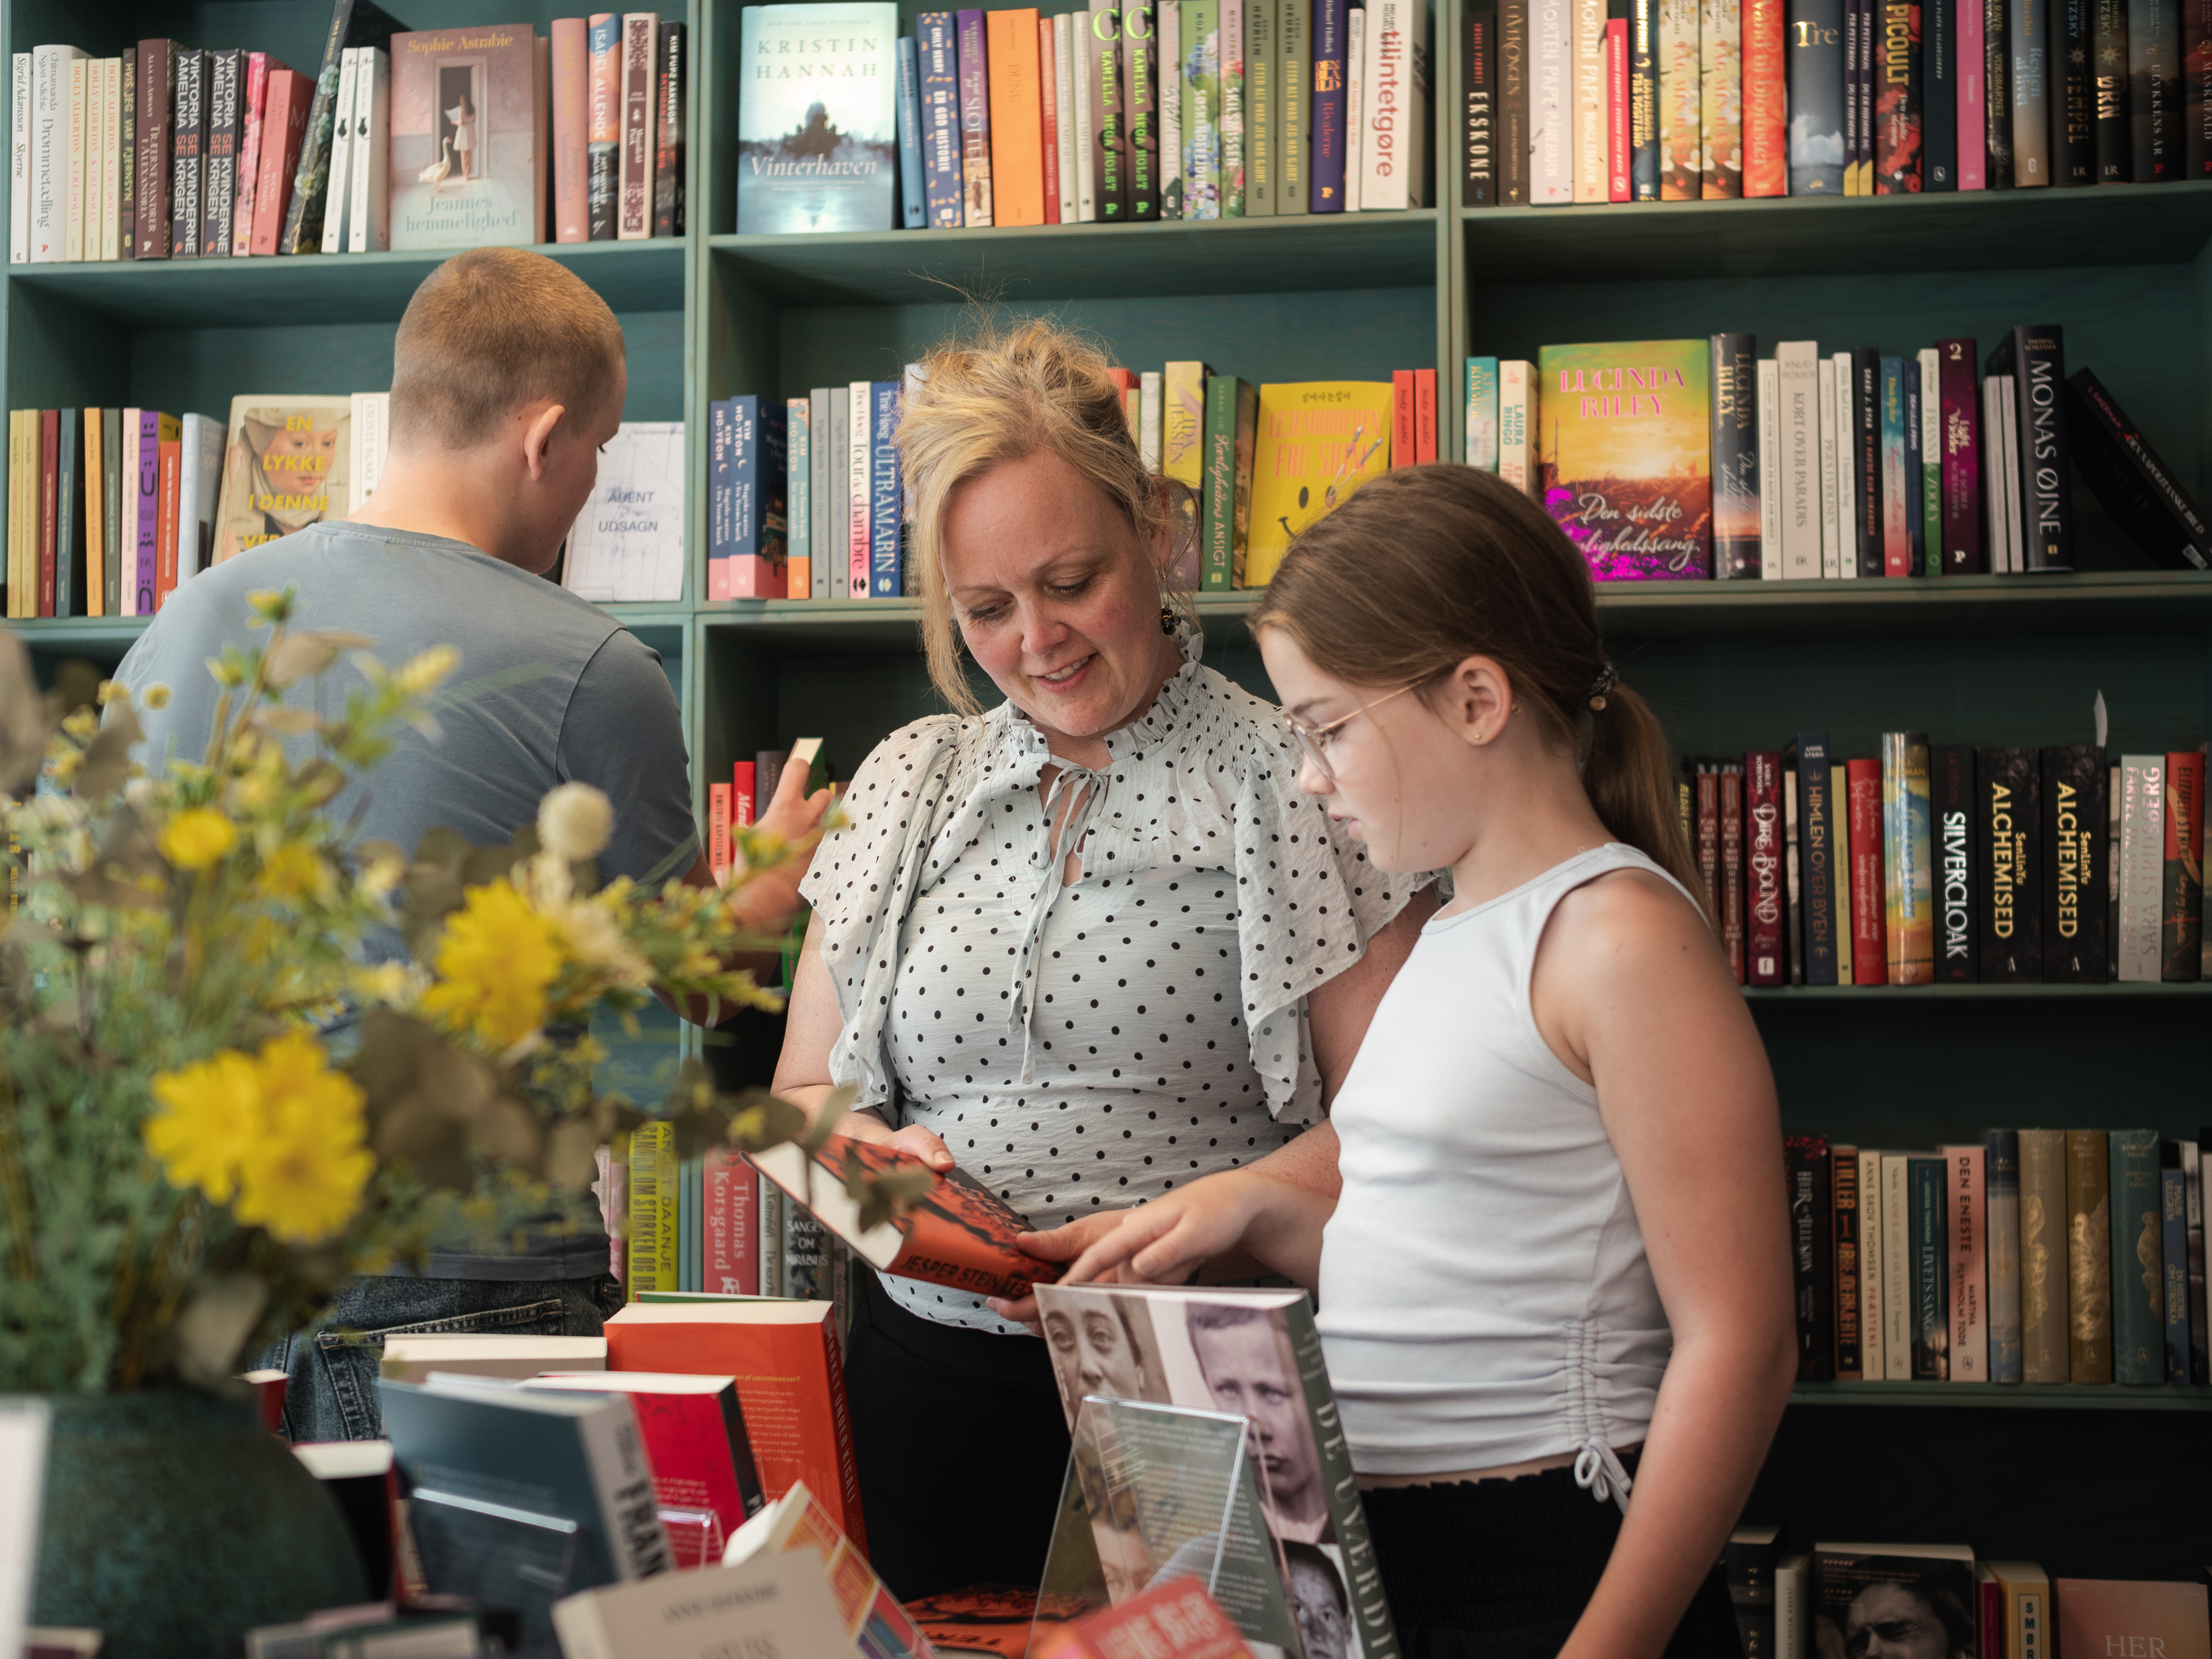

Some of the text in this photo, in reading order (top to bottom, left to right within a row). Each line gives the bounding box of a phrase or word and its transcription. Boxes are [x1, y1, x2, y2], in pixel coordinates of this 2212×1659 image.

[38, 55, 48, 79] Ngozi
[50, 52, 59, 111] Chimamanda
[408, 34, 514, 55] Sophie Astrabie
[668, 35, 678, 124] KIM AAKESON
[757, 38, 877, 55] KRISTIN
[757, 63, 876, 79] HANNAH
[1008, 64, 1020, 102] DUNE
[1542, 0, 1560, 105] MORTEN PAPE
[1580, 0, 1599, 105] MORTEN PAPE
[1753, 0, 1773, 167] Vand blomster
[1886, 5, 1909, 85] PICOULT
[2030, 48, 2042, 97] Resten
[15, 57, 27, 178] Sigrid Adamsson Skyerne
[594, 29, 607, 139] ISABEL ALLENDE
[931, 27, 951, 172] EMILY HENRY EN GOD HISTORIE
[1101, 50, 1117, 191] KAMILLA HEGA HOLST
[1133, 49, 1148, 190] KAMILLA HEGA HOLST
[1254, 63, 1266, 183] EFTER ALT HVAD JEG HAR GJORT
[1286, 61, 1298, 181] EFTER ALT HVAD JEG HAR GJORT
[1372, 30, 1402, 177] tilintetgøre
[1994, 53, 2003, 118] VOKSBARNET
[2016, 74, 2030, 107] livet
[2067, 76, 2088, 143] TEMPEL
[2097, 76, 2122, 119] ØRN
[2152, 65, 2164, 155] ULYKKENS ÅR
[2203, 62, 2212, 139] MASKEFALD
[123, 63, 133, 201] HVIS JEG VAR FJERNSYN
[175, 56, 188, 220] AMELINA SE KRIGEN
[185, 56, 199, 254] VIKTORIA SE KVINDERNE
[207, 56, 224, 219] AMELINA SE KRIGEN
[217, 55, 236, 253] VIKTORIA SE KVINDERNE
[751, 152, 876, 176] Vinterhaven
[1194, 90, 1207, 188] SØSKENDEFEJDEN
[1225, 87, 1239, 166] SKILSMISSEN
[1469, 92, 1490, 180] EKSKONE
[37, 119, 53, 227] Drømmetælling
[140, 144, 149, 219] ALEXANDRIA
[149, 124, 160, 232] TRÆERNE VANDRER
[427, 194, 493, 215] Jeannes
[406, 212, 517, 233] hemmelighed
[1561, 367, 1685, 393] LUCINDA
[1581, 394, 1668, 418] RILEY
[1718, 365, 1735, 417] RILEY
[1735, 354, 1750, 430] LUCINDA
[286, 416, 312, 432] EN
[1167, 404, 1184, 465] JESSEN
[1183, 418, 1195, 448] IDA
[1274, 444, 1312, 479] FRU
[1503, 406, 1512, 445] RINGO
[1514, 404, 1523, 445] LAURA
[1793, 392, 1808, 527] KORT OVER PARADIS
[1925, 408, 1937, 459] FRANNY
[2030, 360, 2061, 535] MONAS ØJNE
[248, 494, 329, 511] I DENNE
[263, 455, 325, 472] LYKKE
[852, 389, 869, 569] Tine Tour chambre
[1208, 435, 1230, 567] Kærlighedens ANSIGT
[598, 521, 658, 533] UDSAGN
[875, 445, 895, 572] ULTRAMARIN
[1578, 493, 1682, 525] Den sidste
[715, 825, 723, 866] KAPITELMAN
[1752, 803, 1779, 924] DIRE BOUND
[1808, 786, 1827, 940] HIMLEN OVER BYEN
[1993, 781, 2013, 939] ALCHEMISED
[2016, 831, 2026, 885] SenLinYu
[2058, 780, 2077, 938] ALCHEMISED
[2080, 831, 2092, 885] SenLinYu
[2140, 767, 2160, 956] SARA STRIDSBERG
[1943, 811, 1968, 960] SILVERCLOAK
[709, 1171, 730, 1270] Korsgaard
[733, 1181, 749, 1259] Thomas
[1836, 1161, 1856, 1209] TILLER
[1866, 1161, 1875, 1281] ANNE THOMSEN
[1959, 1157, 1972, 1253] DEN ENESTE
[633, 1179, 657, 1272] OM STORKEN OG
[660, 1195, 672, 1272] DAANJE
[785, 1254, 828, 1267] MIRABILIS
[798, 1238, 815, 1250] OM
[900, 1255, 1001, 1290] JESPER STEIN
[1922, 1246, 1935, 1330] LIVETS SANG
[834, 1393, 856, 1503] UNDER KIGALI
[1315, 1402, 1338, 1461] DE
[2103, 1634, 2167, 1658] HER
